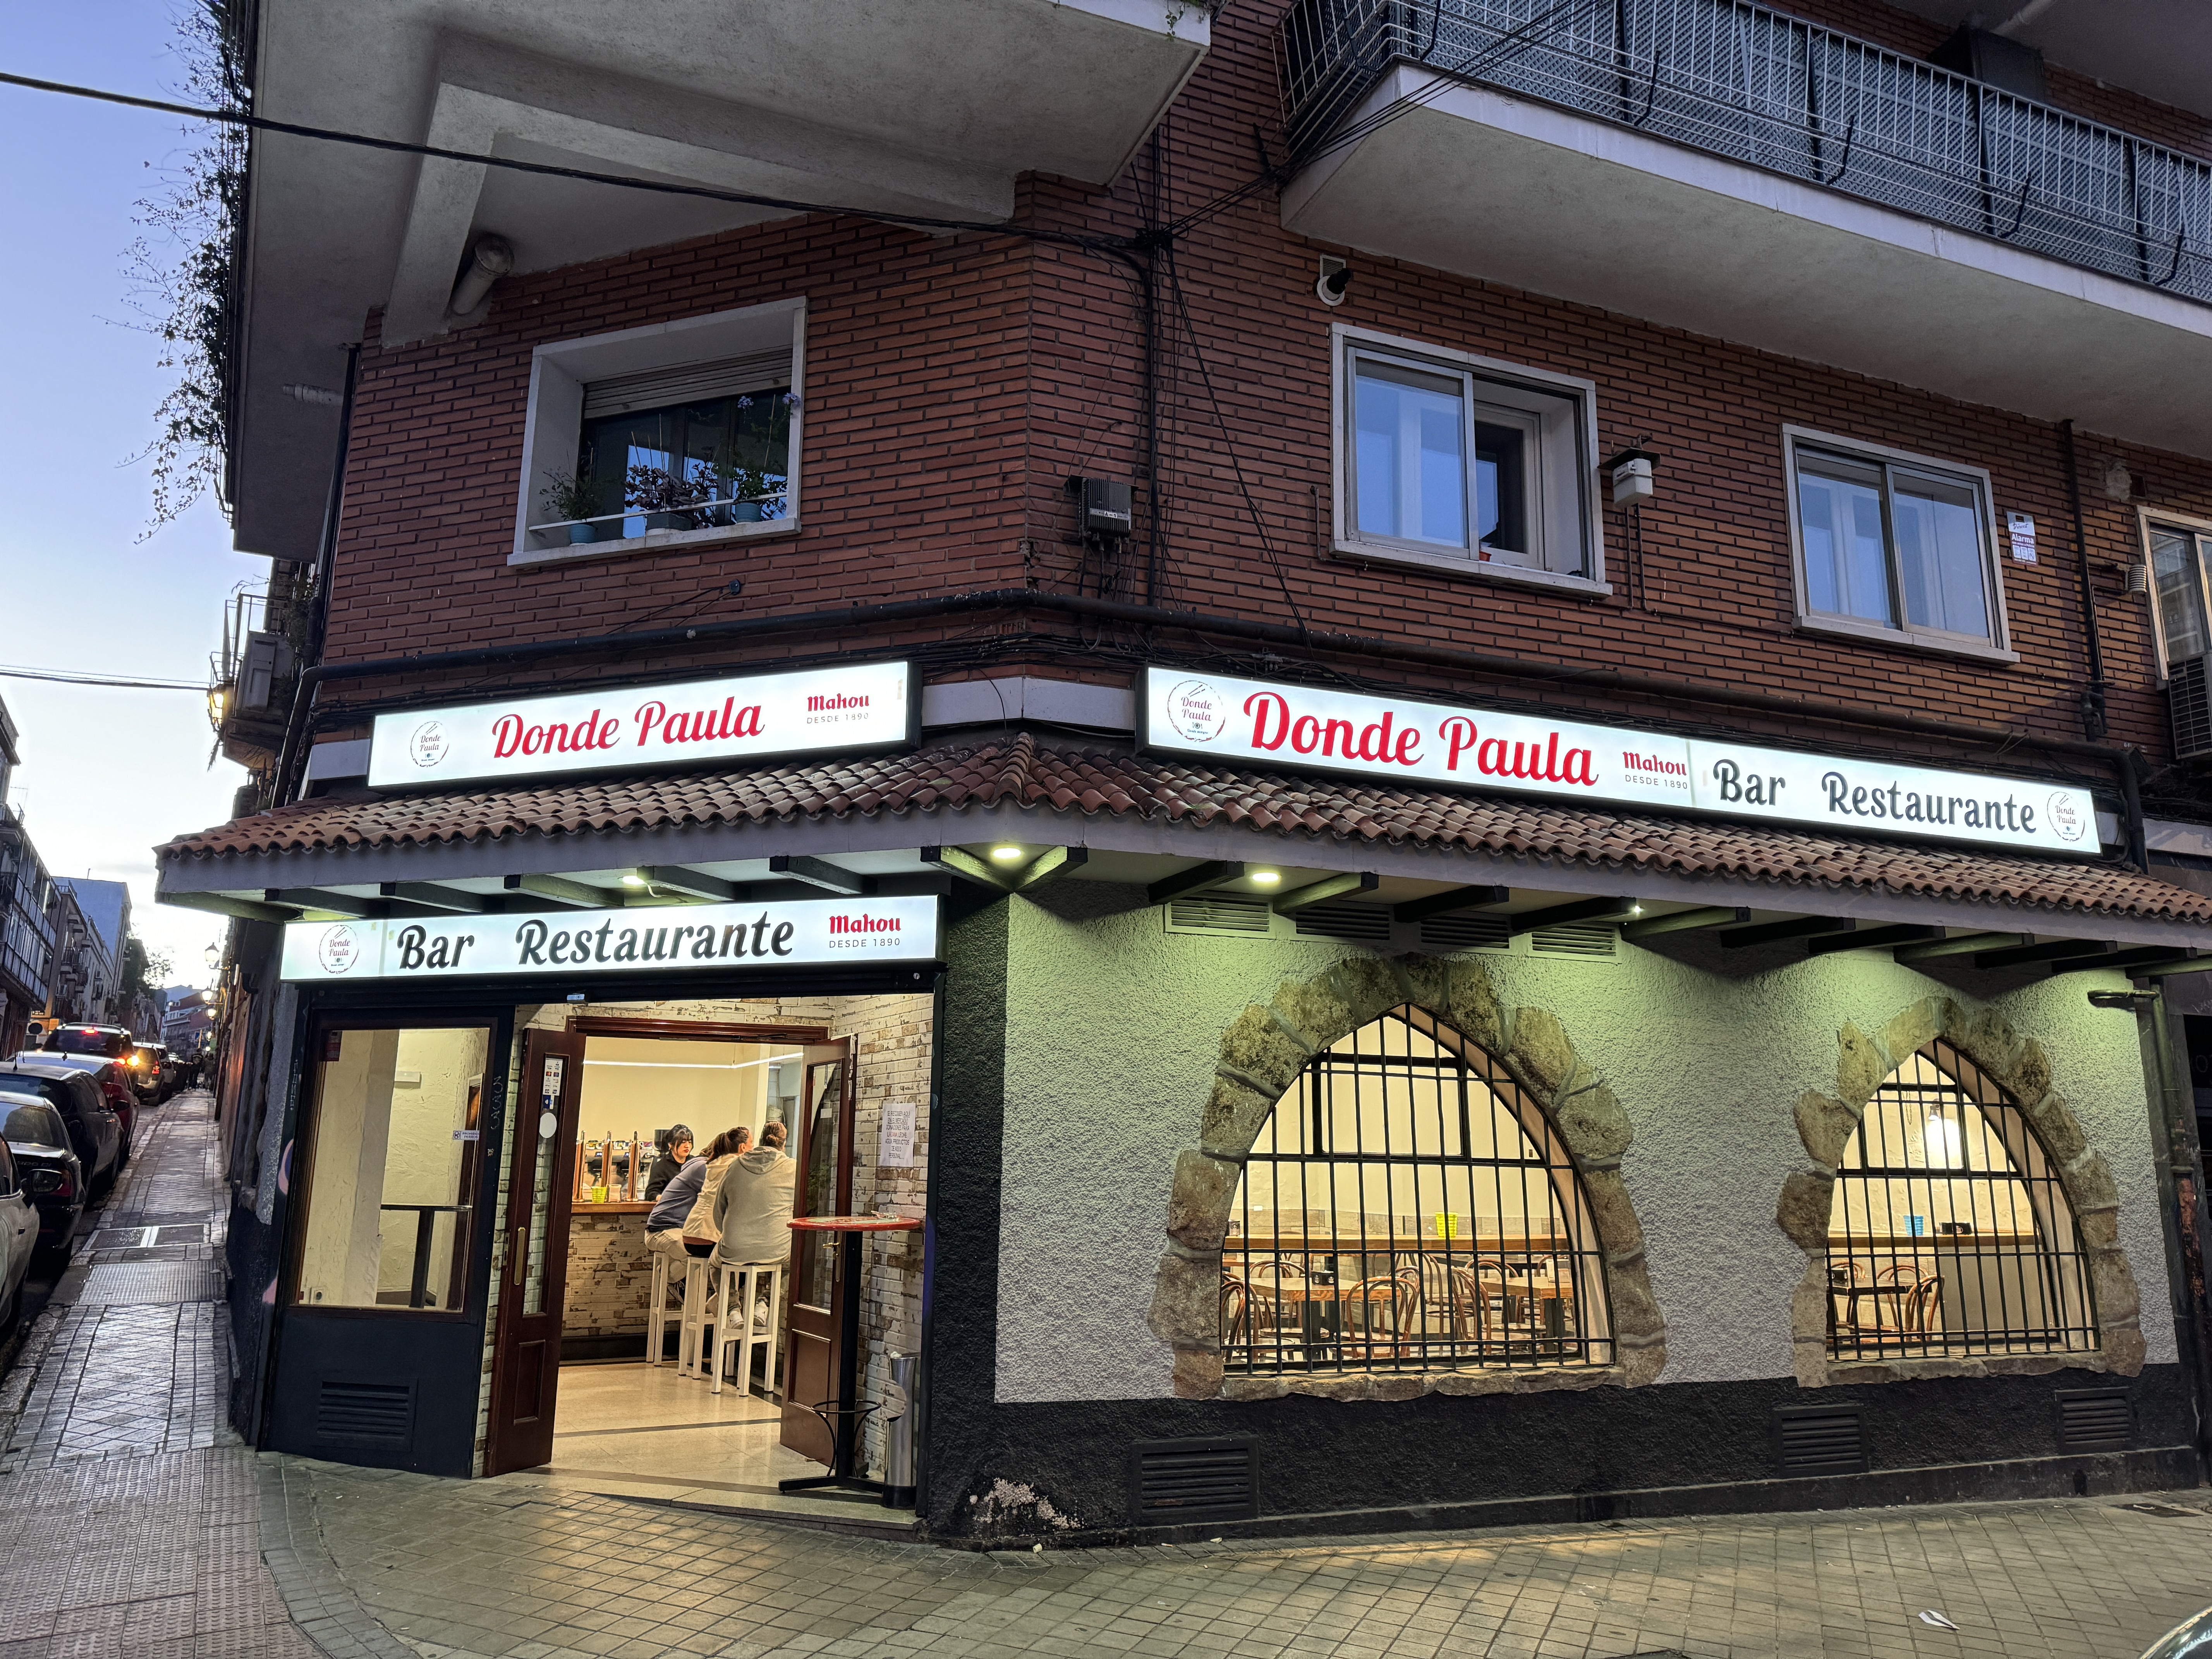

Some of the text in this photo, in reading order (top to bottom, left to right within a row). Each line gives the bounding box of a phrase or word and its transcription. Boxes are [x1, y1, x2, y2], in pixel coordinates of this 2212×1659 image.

[2011, 533, 2034, 544] Alarma
[807, 693, 869, 712] Mahou
[1181, 696, 1212, 709] Donde
[807, 713, 869, 724] DESDE 1890
[1182, 709, 1212, 721] Paula
[492, 696, 765, 758] Donde Paula
[421, 734, 441, 743] Donde
[1243, 691, 1599, 786] Donde Paula
[420, 743, 439, 752] Paula
[1622, 751, 1687, 776] Mahou
[1625, 775, 1688, 790] DESDE 1890
[1713, 759, 2037, 834] Bar Restaurante
[2055, 805, 2076, 815] Donde
[2057, 814, 2076, 824] Paula
[830, 913, 901, 934] Mahou
[329, 939, 350, 947] Donde
[397, 910, 794, 970] Bar Restaurante
[829, 938, 900, 948] DESDE 1890
[329, 948, 349, 957] Paula
